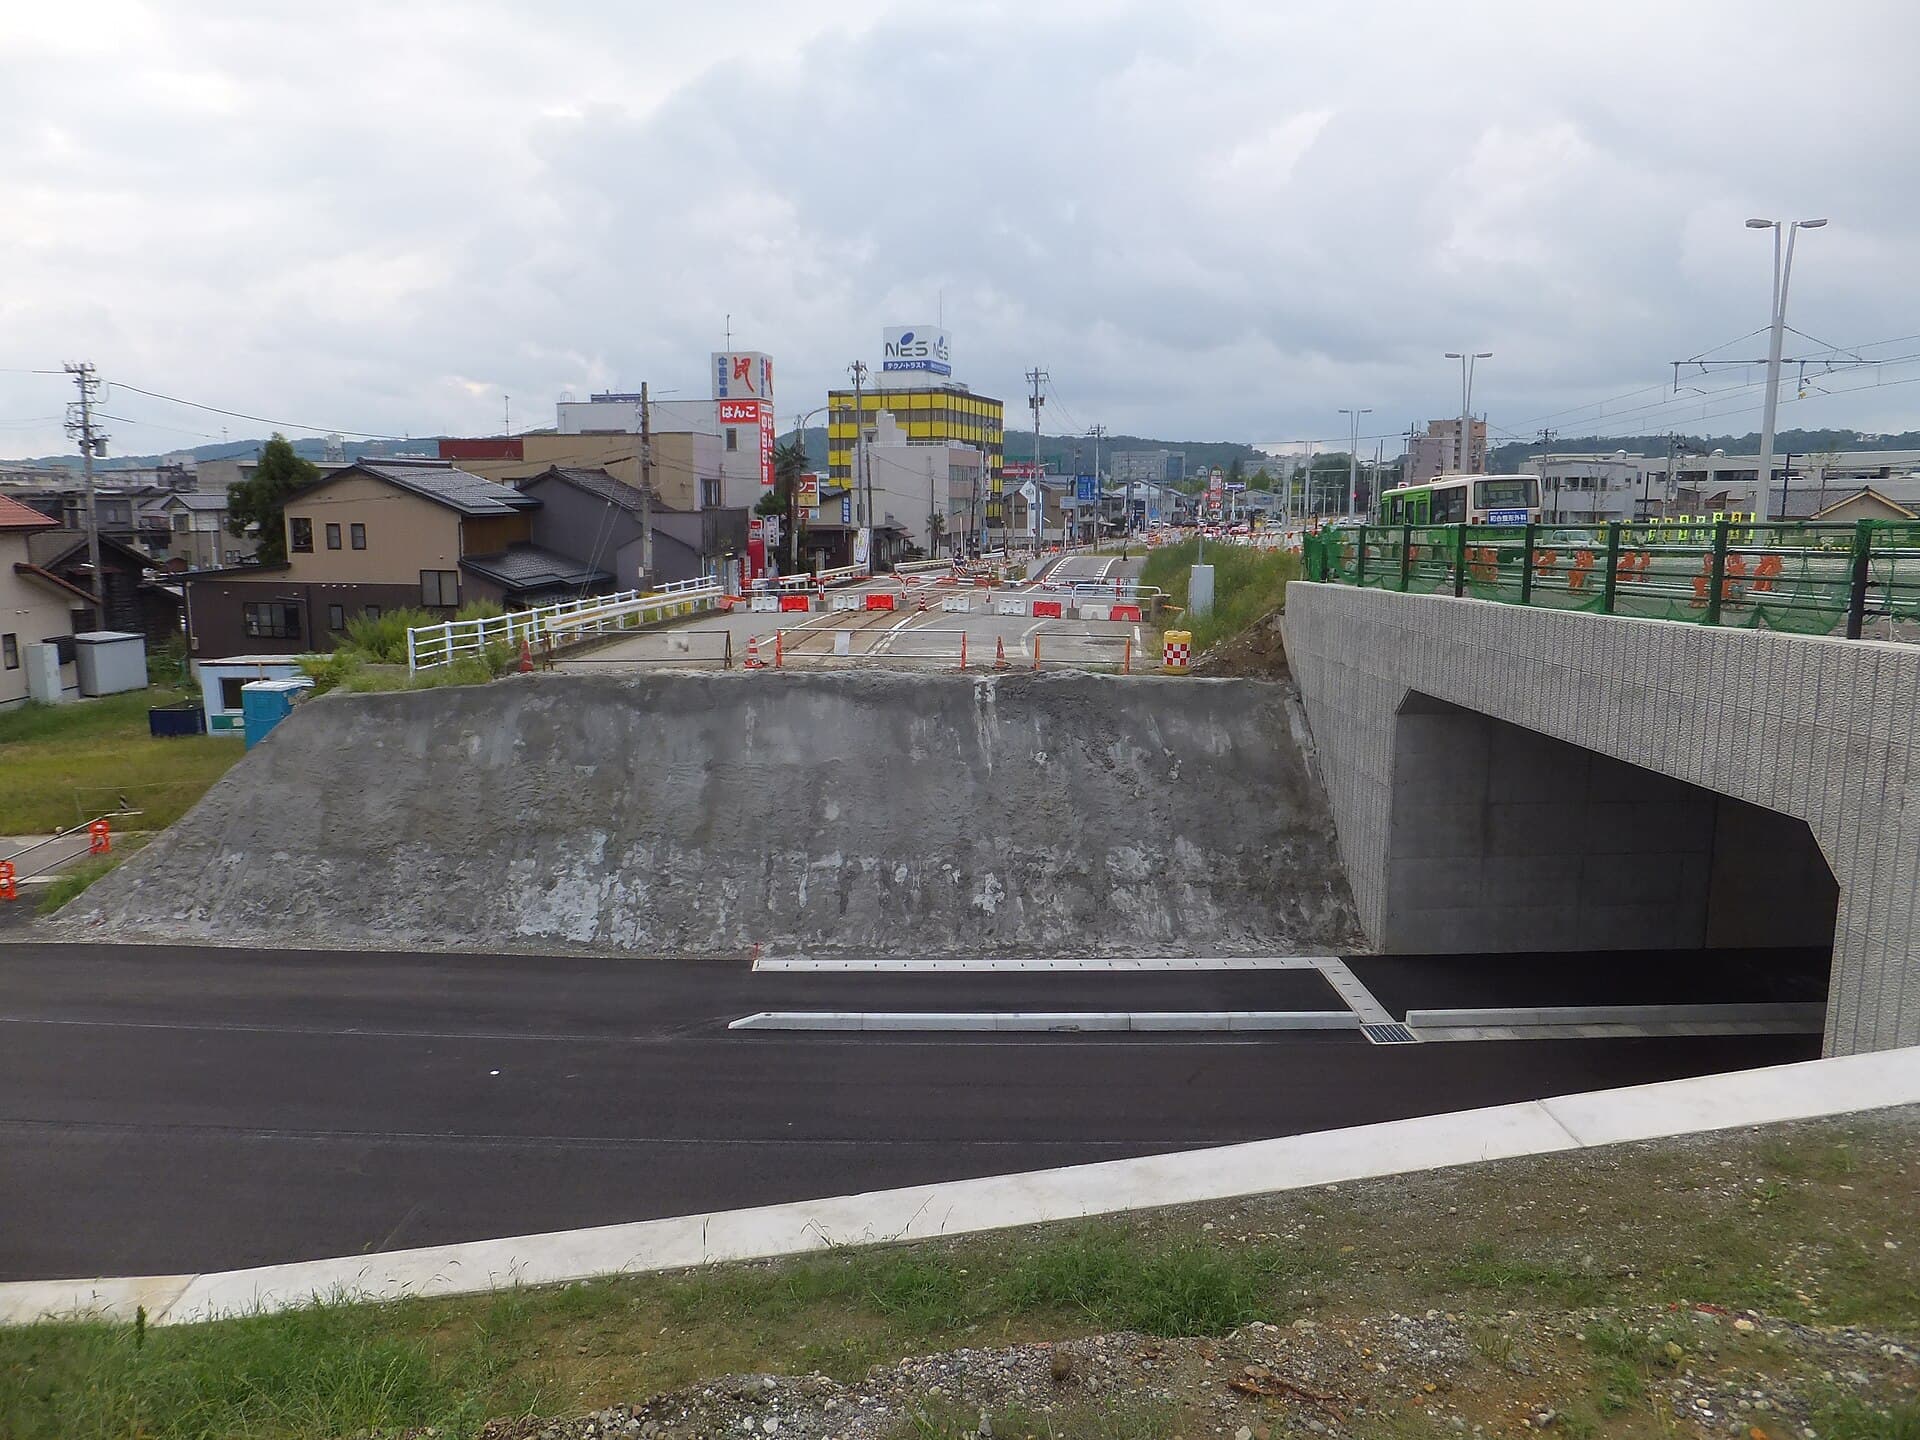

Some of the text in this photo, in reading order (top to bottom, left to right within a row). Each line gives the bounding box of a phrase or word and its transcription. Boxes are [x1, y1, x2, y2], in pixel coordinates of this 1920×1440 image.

[885, 341, 928, 357] NES
[722, 405, 756, 418] はんこ
